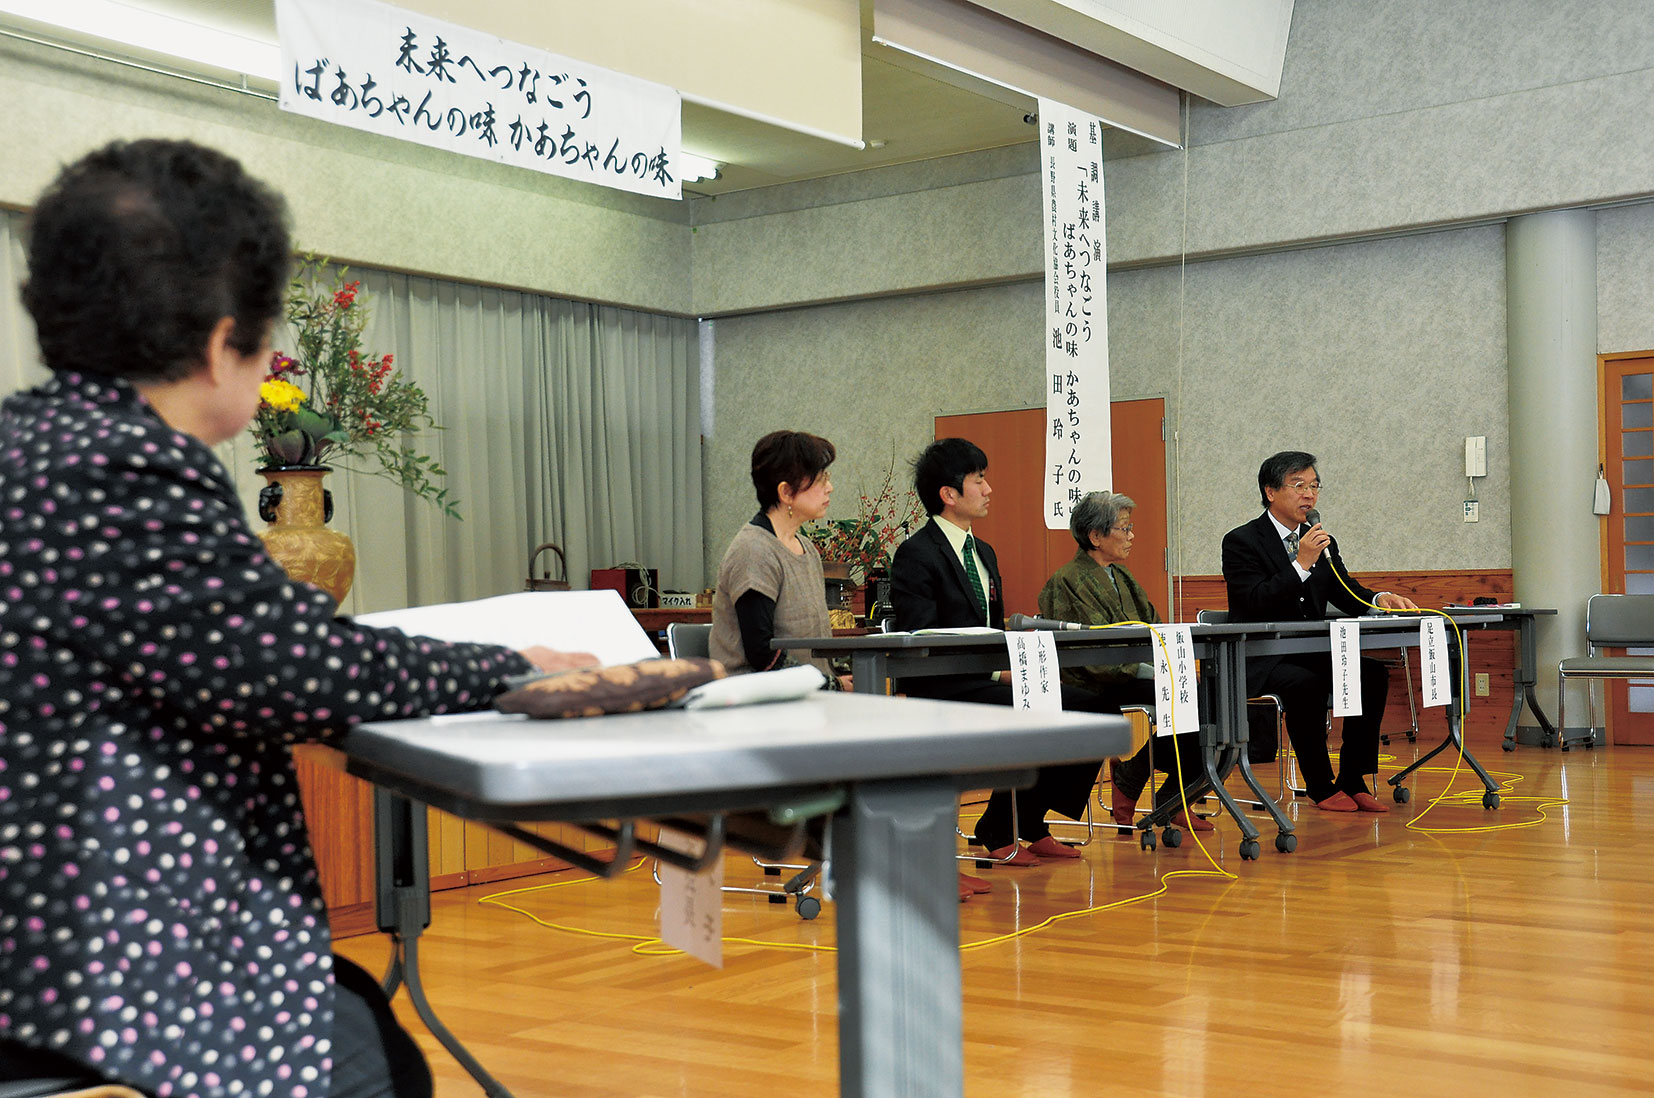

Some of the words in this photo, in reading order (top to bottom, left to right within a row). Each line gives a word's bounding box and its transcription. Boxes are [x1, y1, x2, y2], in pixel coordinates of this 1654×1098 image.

[295, 58, 498, 147] ばあちゃんの味
[510, 115, 674, 187] かあちゃんの味
[395, 26, 592, 118] 未来へつなごう
[1067, 121, 1078, 152] 演題
[1076, 165, 1093, 343] 「未来へつなごう
[1089, 121, 1102, 262] 基調講演
[1062, 222, 1079, 358] ばあちゃんの味
[1052, 327, 1064, 517] 池田玲子氏
[662, 597, 692, 606] マイク入れ
[1016, 636, 1031, 712] 高橋まゆみ
[1037, 635, 1049, 694] 人形作家
[1175, 631, 1189, 704] 飯山小学校
